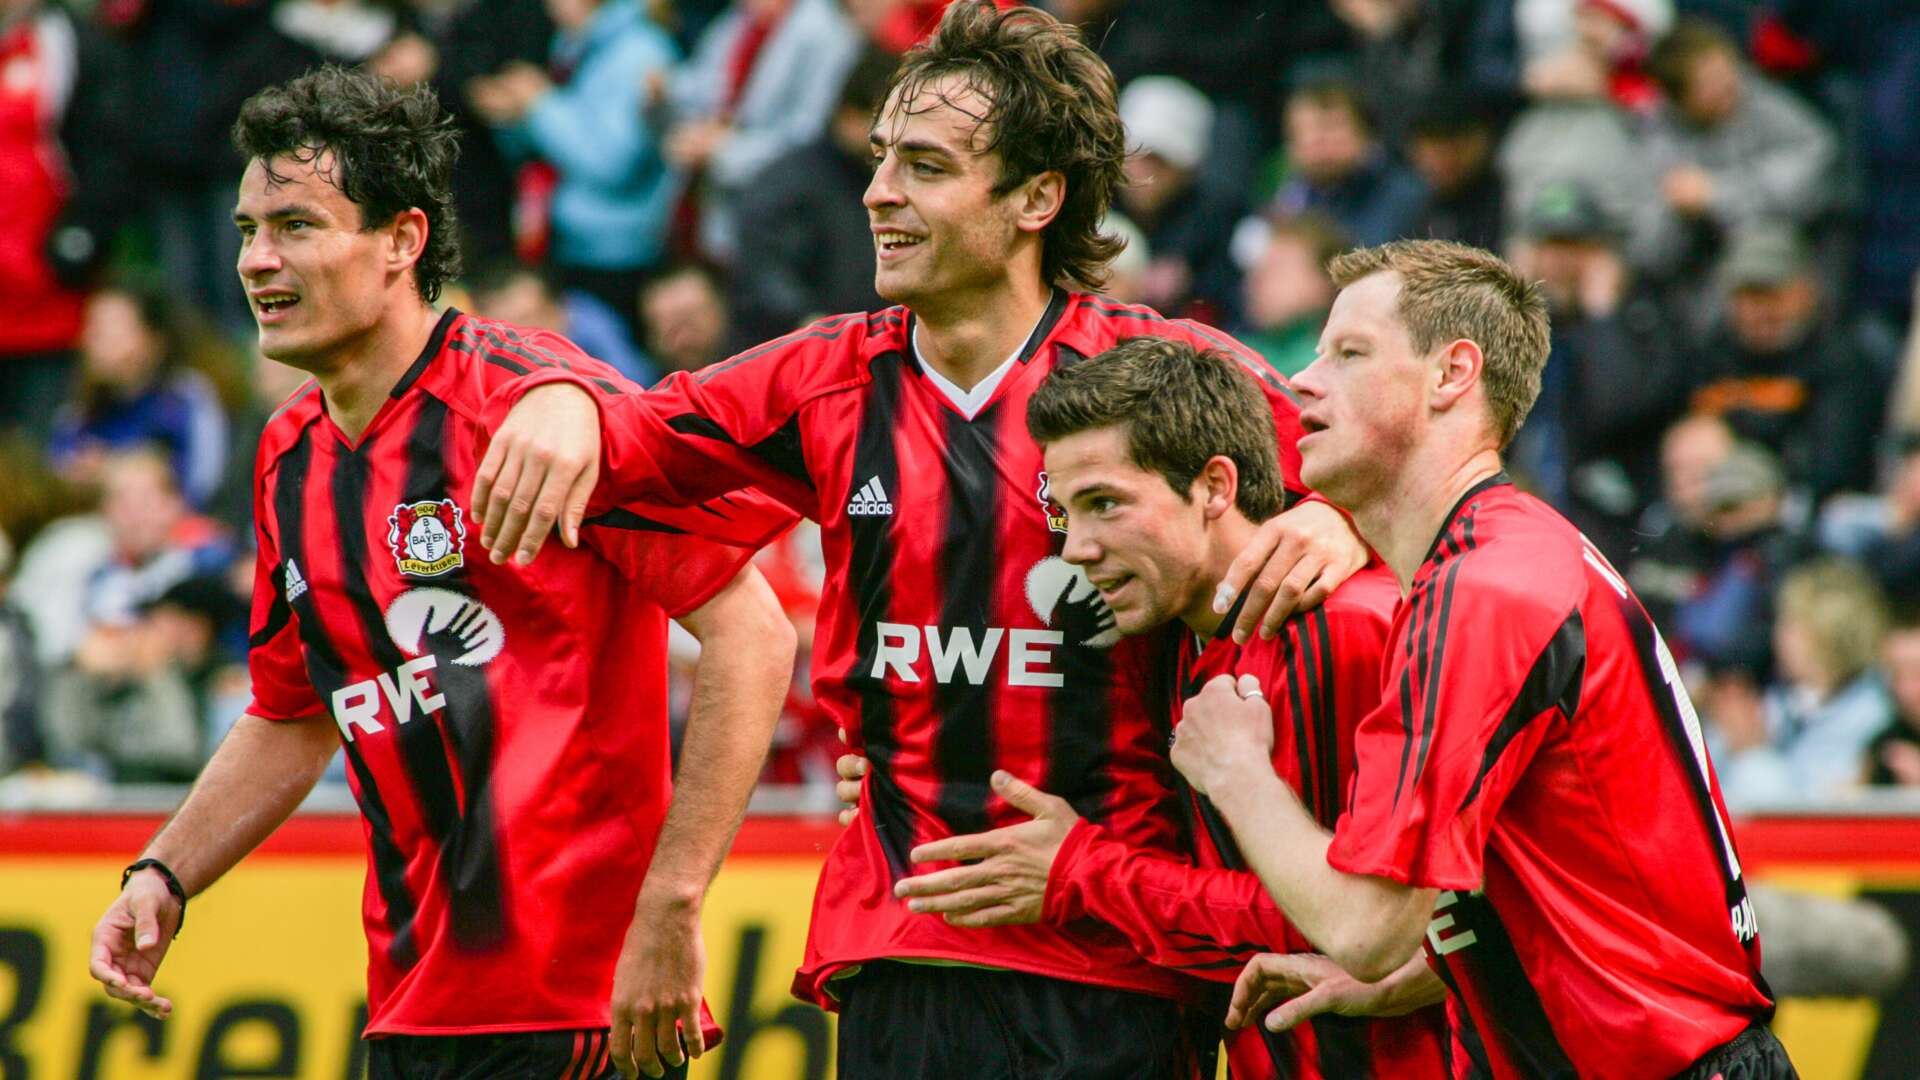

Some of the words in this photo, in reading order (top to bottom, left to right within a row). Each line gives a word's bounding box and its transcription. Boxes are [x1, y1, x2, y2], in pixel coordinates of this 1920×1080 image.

[847, 499, 893, 515] adidas
[412, 533, 444, 545] BAYER
[423, 518, 434, 559] BAYER
[870, 622, 1064, 688] RWE
